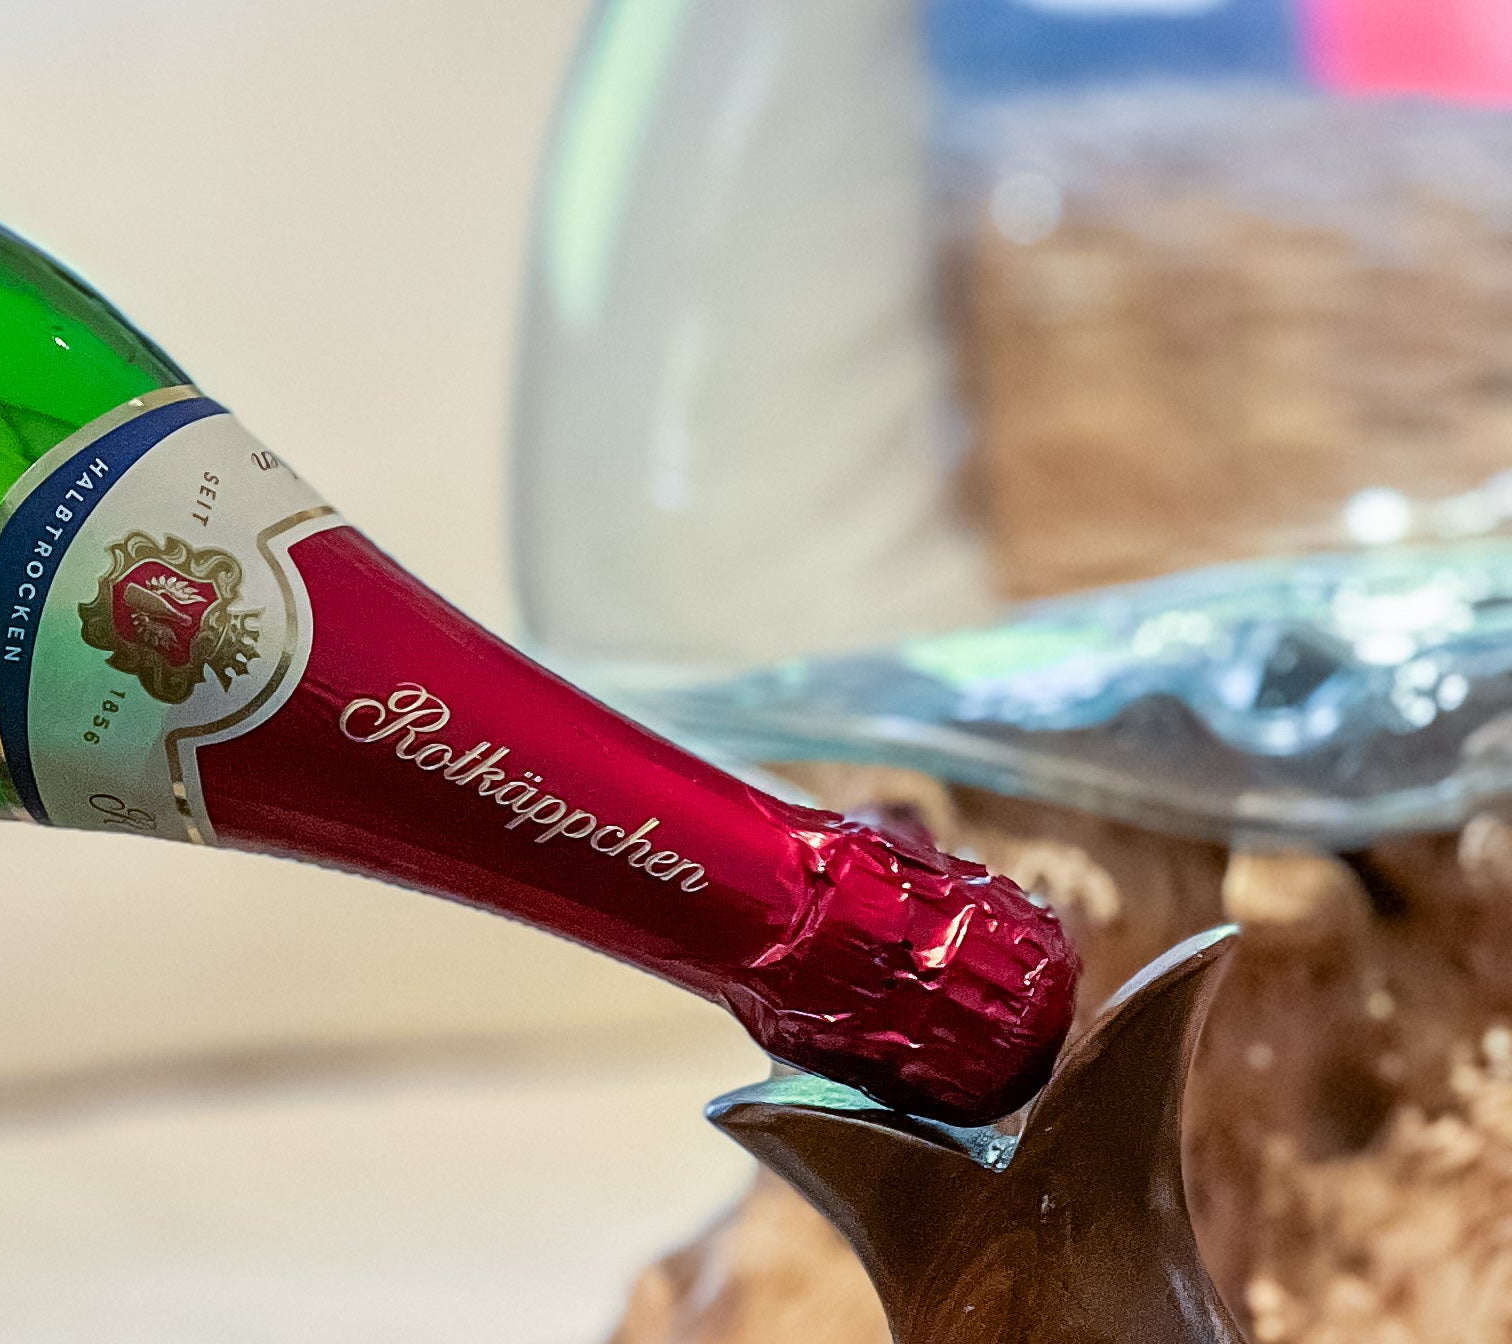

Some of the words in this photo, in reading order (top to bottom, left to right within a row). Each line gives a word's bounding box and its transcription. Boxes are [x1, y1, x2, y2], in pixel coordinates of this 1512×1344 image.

[3, 458, 109, 663] HALBTROCKEN
[192, 471, 220, 527] SEIT
[83, 688, 126, 745] 1856
[339, 681, 709, 892] Rotkäppchen
